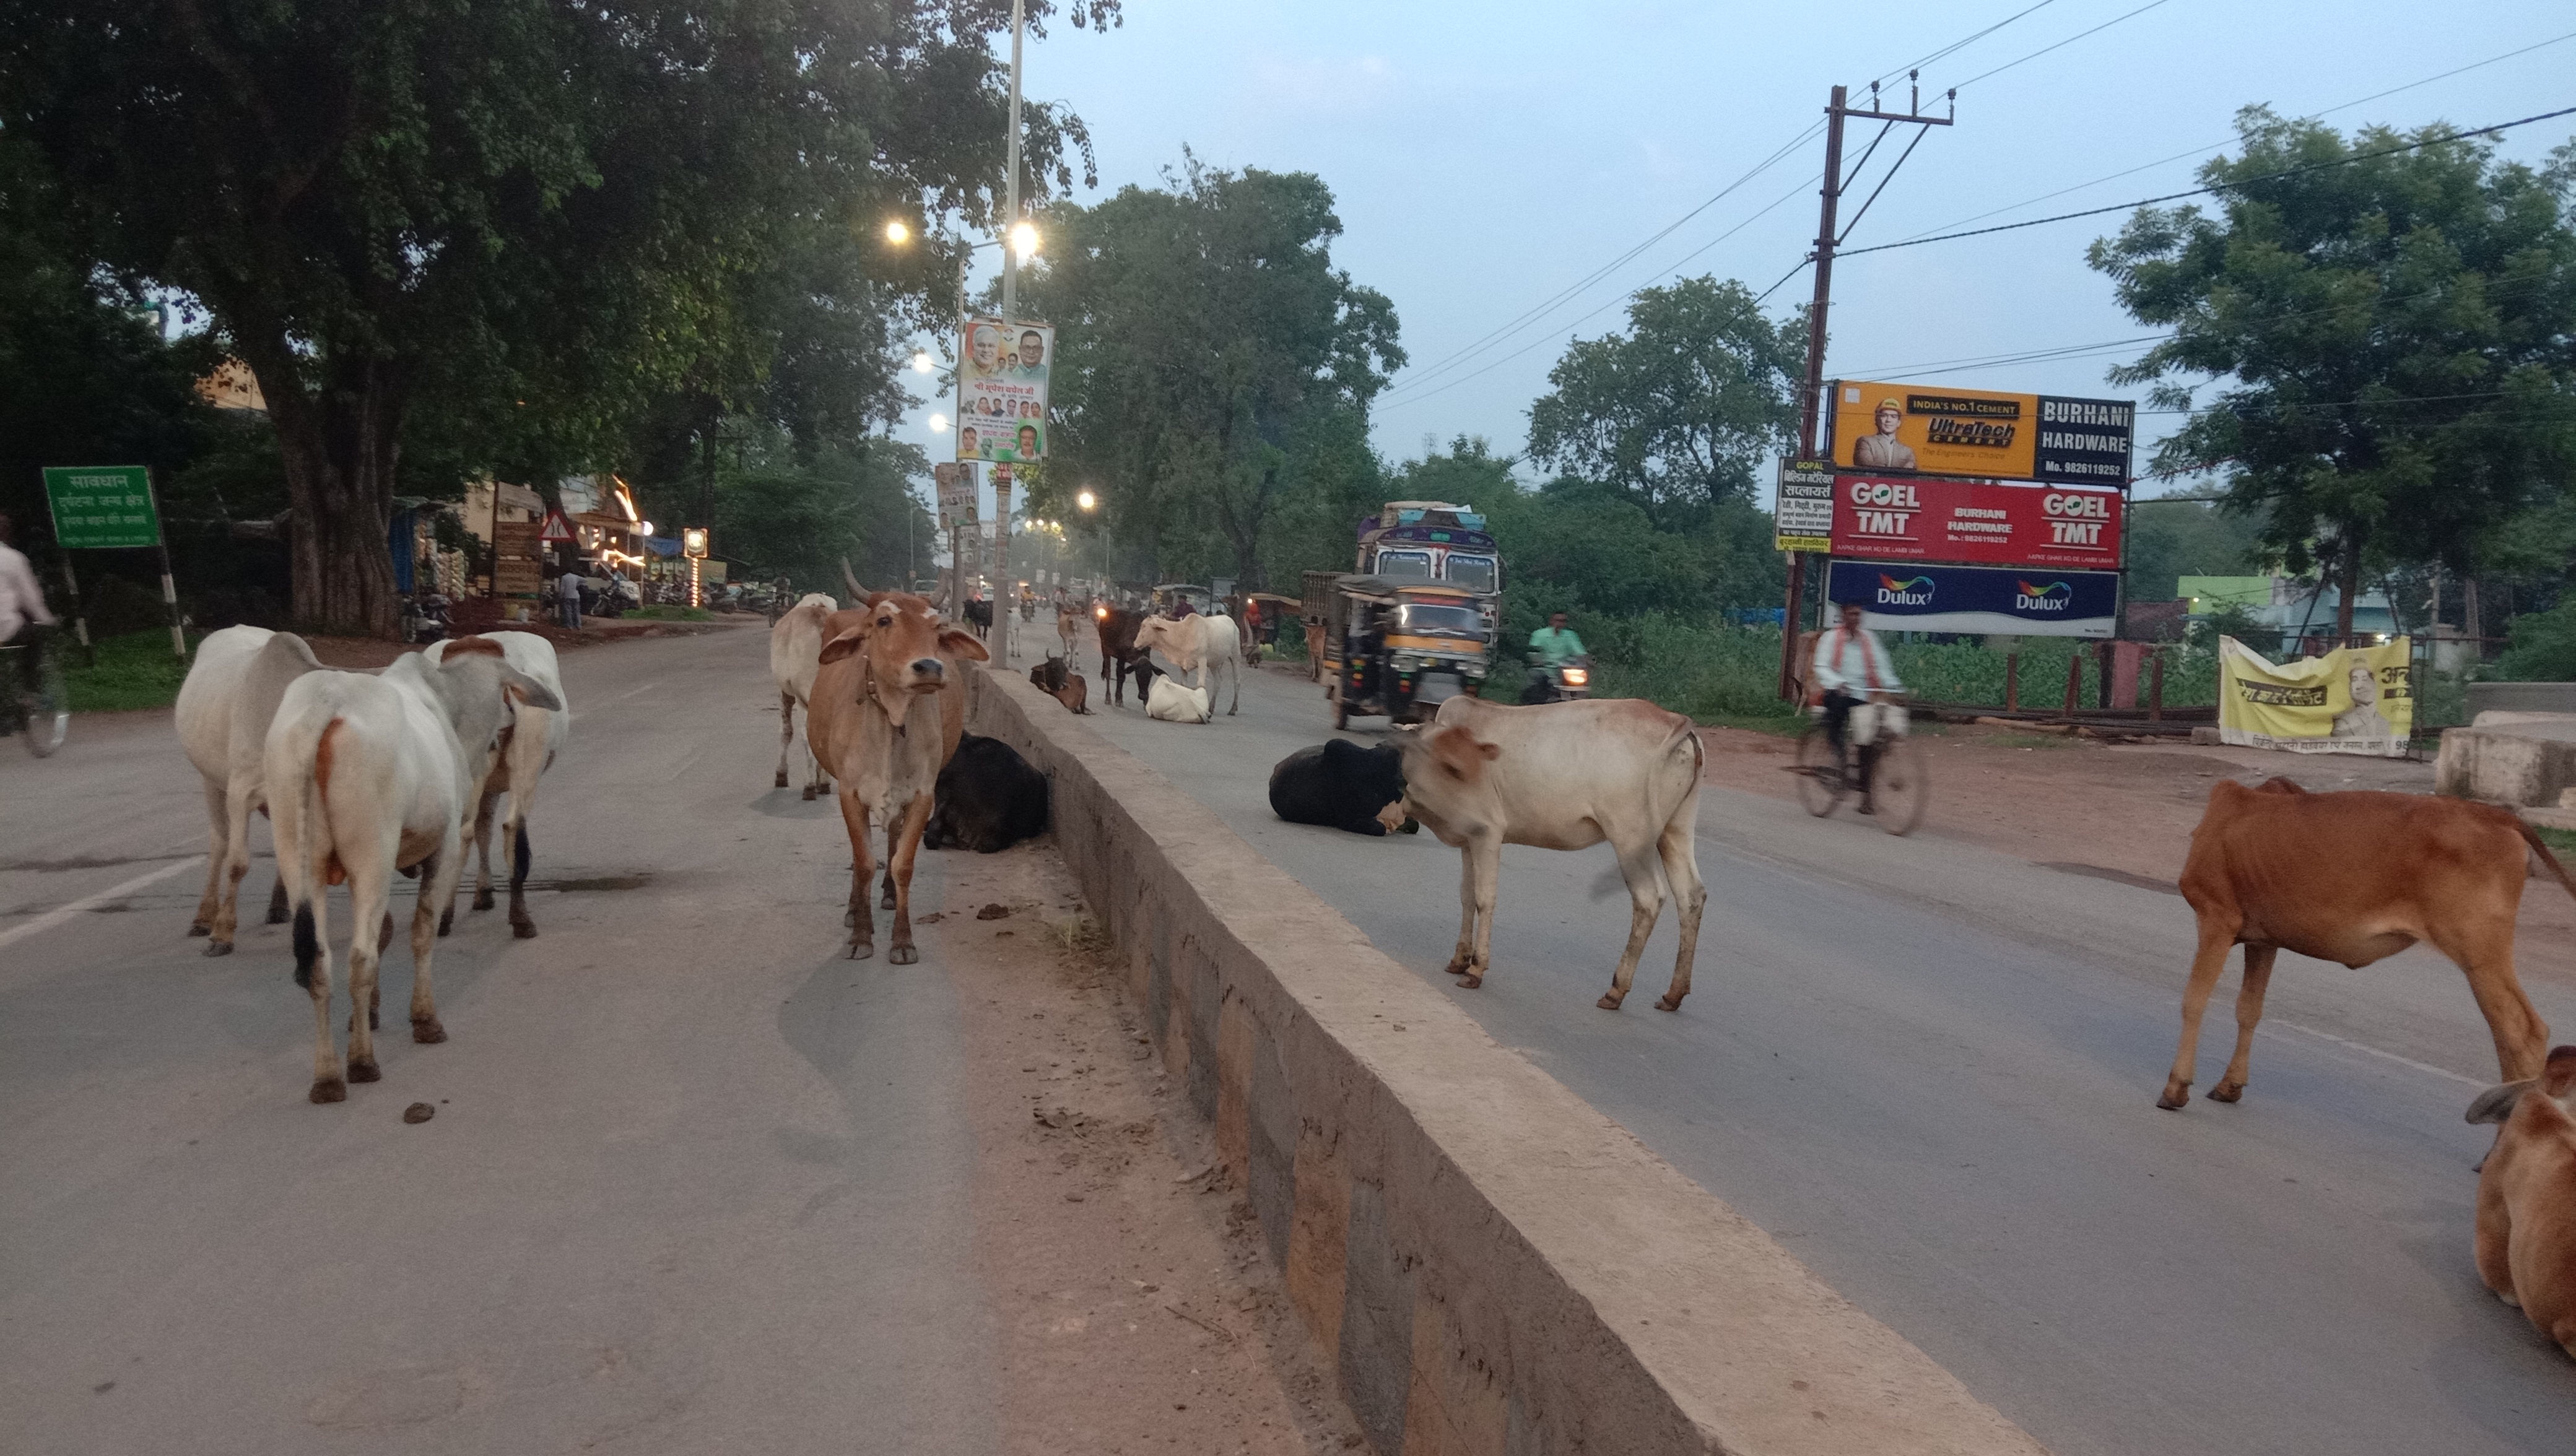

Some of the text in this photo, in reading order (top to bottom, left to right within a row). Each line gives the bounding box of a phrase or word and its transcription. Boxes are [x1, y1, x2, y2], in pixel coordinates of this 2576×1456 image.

[1913, 400, 1949, 410] INDIA'S
[1977, 404, 2015, 414] CEMENT
[2043, 401, 2129, 427] BURHANI
[1928, 417, 2016, 438] UltraTech
[1933, 435, 2008, 446] CEMENT
[2042, 431, 2127, 453] HARDWARE
[1796, 461, 1824, 470] GOPAL
[2045, 461, 2120, 475] Mo. 9826119252
[68, 474, 129, 489] सावधान
[1785, 485, 1831, 497] सप्लायर्स
[1850, 482, 1920, 507] GOEL
[1954, 508, 2006, 519] BURHANI
[2043, 493, 2110, 518] GOEL
[1856, 511, 1910, 534] TMT
[1947, 521, 2012, 534] HARDWARE
[2051, 522, 2102, 545] TMT
[1878, 588, 1926, 605] Dulux
[2016, 594, 2063, 610] Dulux
